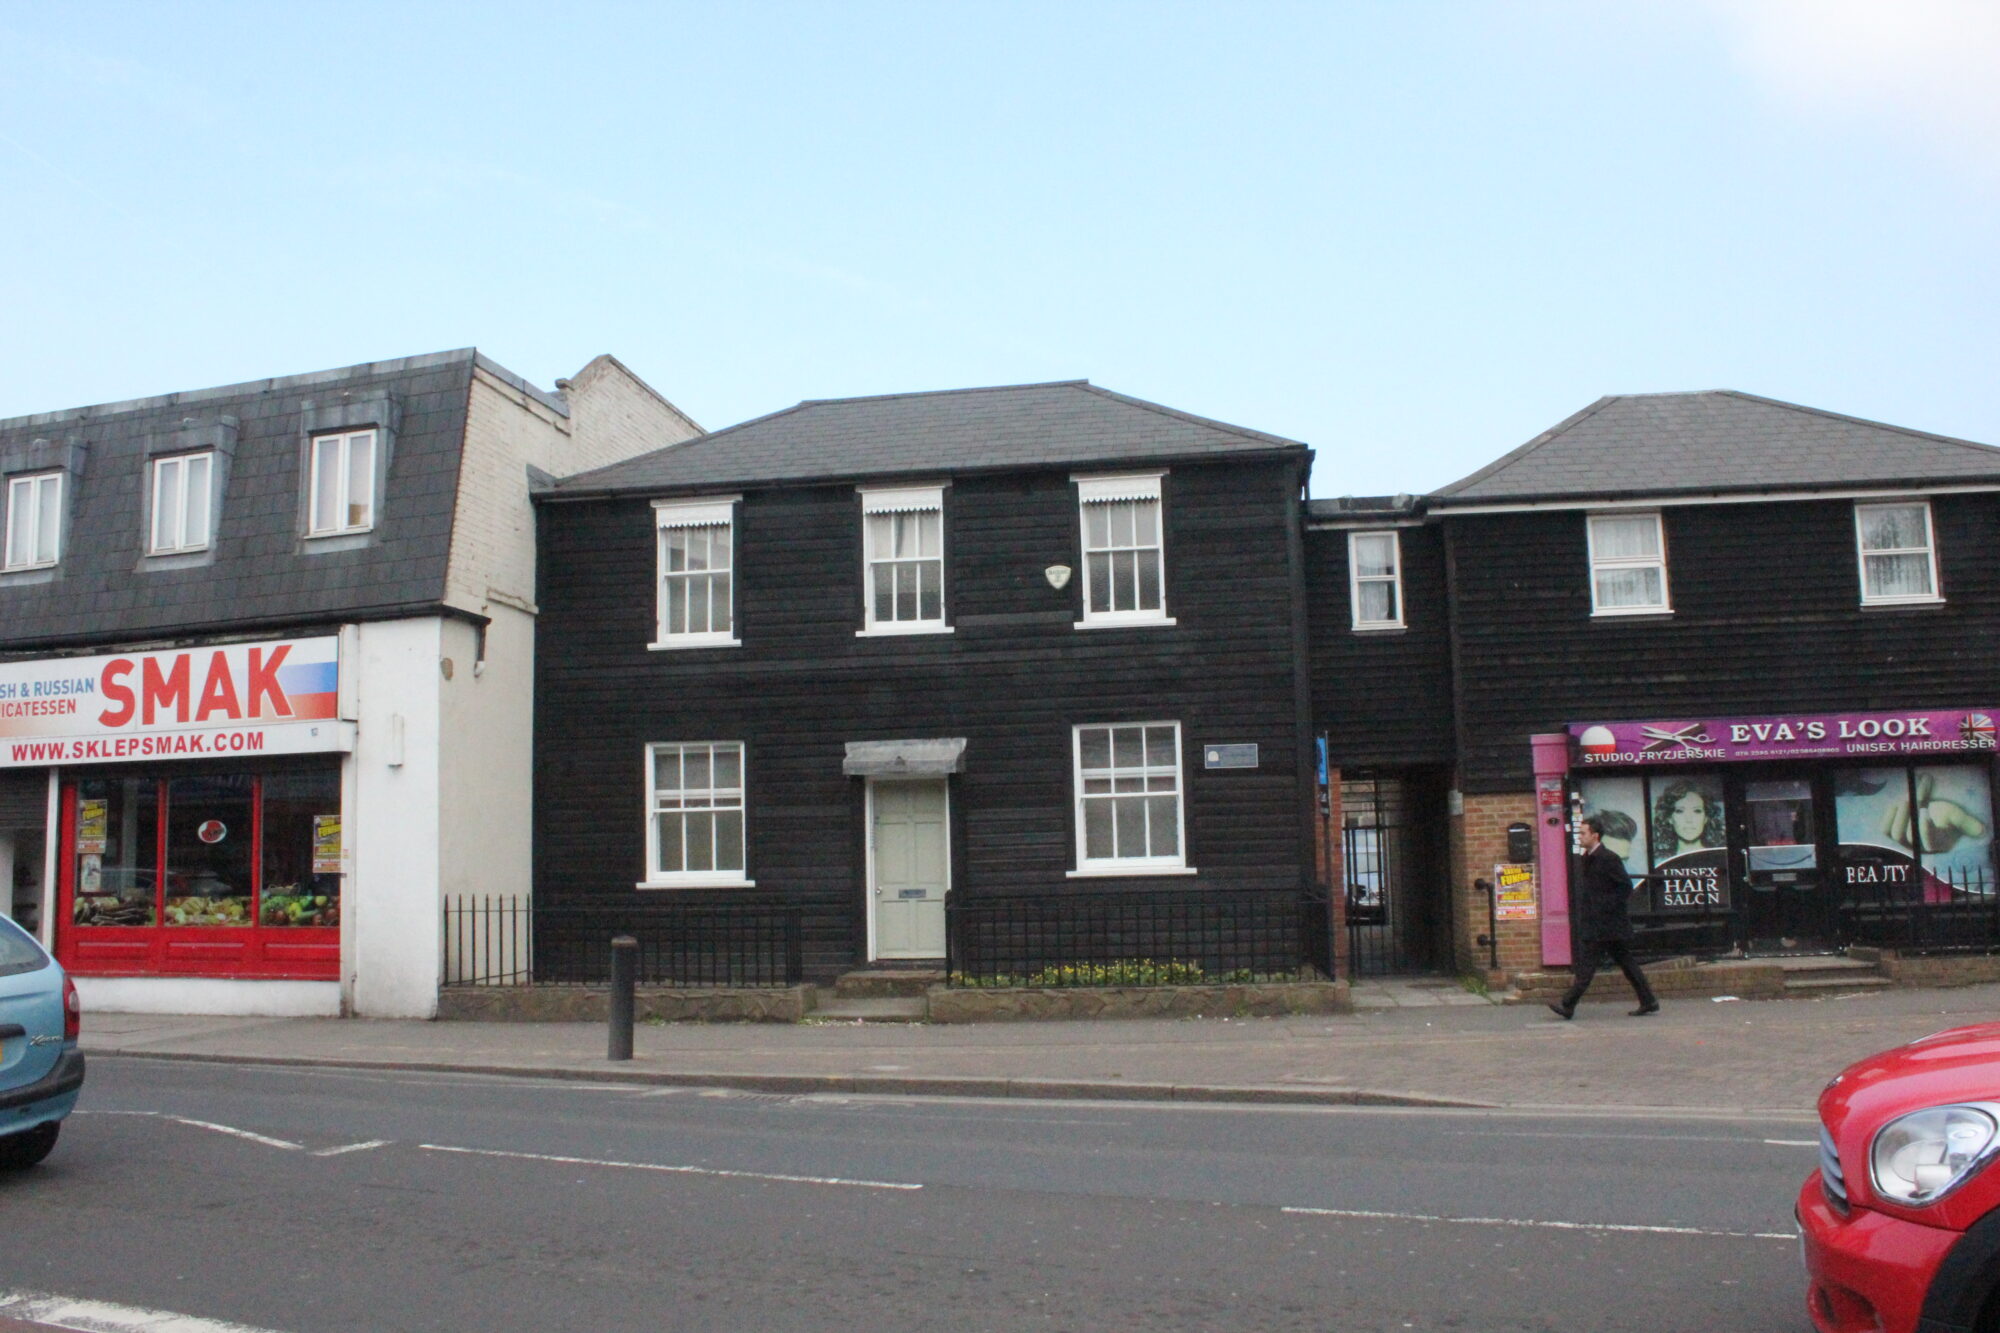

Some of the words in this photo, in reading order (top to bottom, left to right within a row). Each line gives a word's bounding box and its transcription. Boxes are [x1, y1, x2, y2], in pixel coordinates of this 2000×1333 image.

[0, 683, 17, 699] SH
[20, 682, 30, 698] &
[34, 677, 95, 697] RUSSIAN
[98, 644, 295, 728] SMAK
[1, 698, 77, 718] ICATESSEN
[1730, 721, 1827, 743] EVA'S
[1839, 717, 1931, 739] LOOK
[11, 731, 265, 762] WWW.SKLEPSMAK.COM
[1584, 752, 1634, 764] STUDIO
[1638, 748, 1726, 762] FRYZJERSKIE
[1846, 742, 1896, 753] UNISEX
[1900, 739, 1997, 751] HAIRDRESSER
[1663, 878, 1720, 893] HAIR
[1664, 892, 1720, 906] SALON
